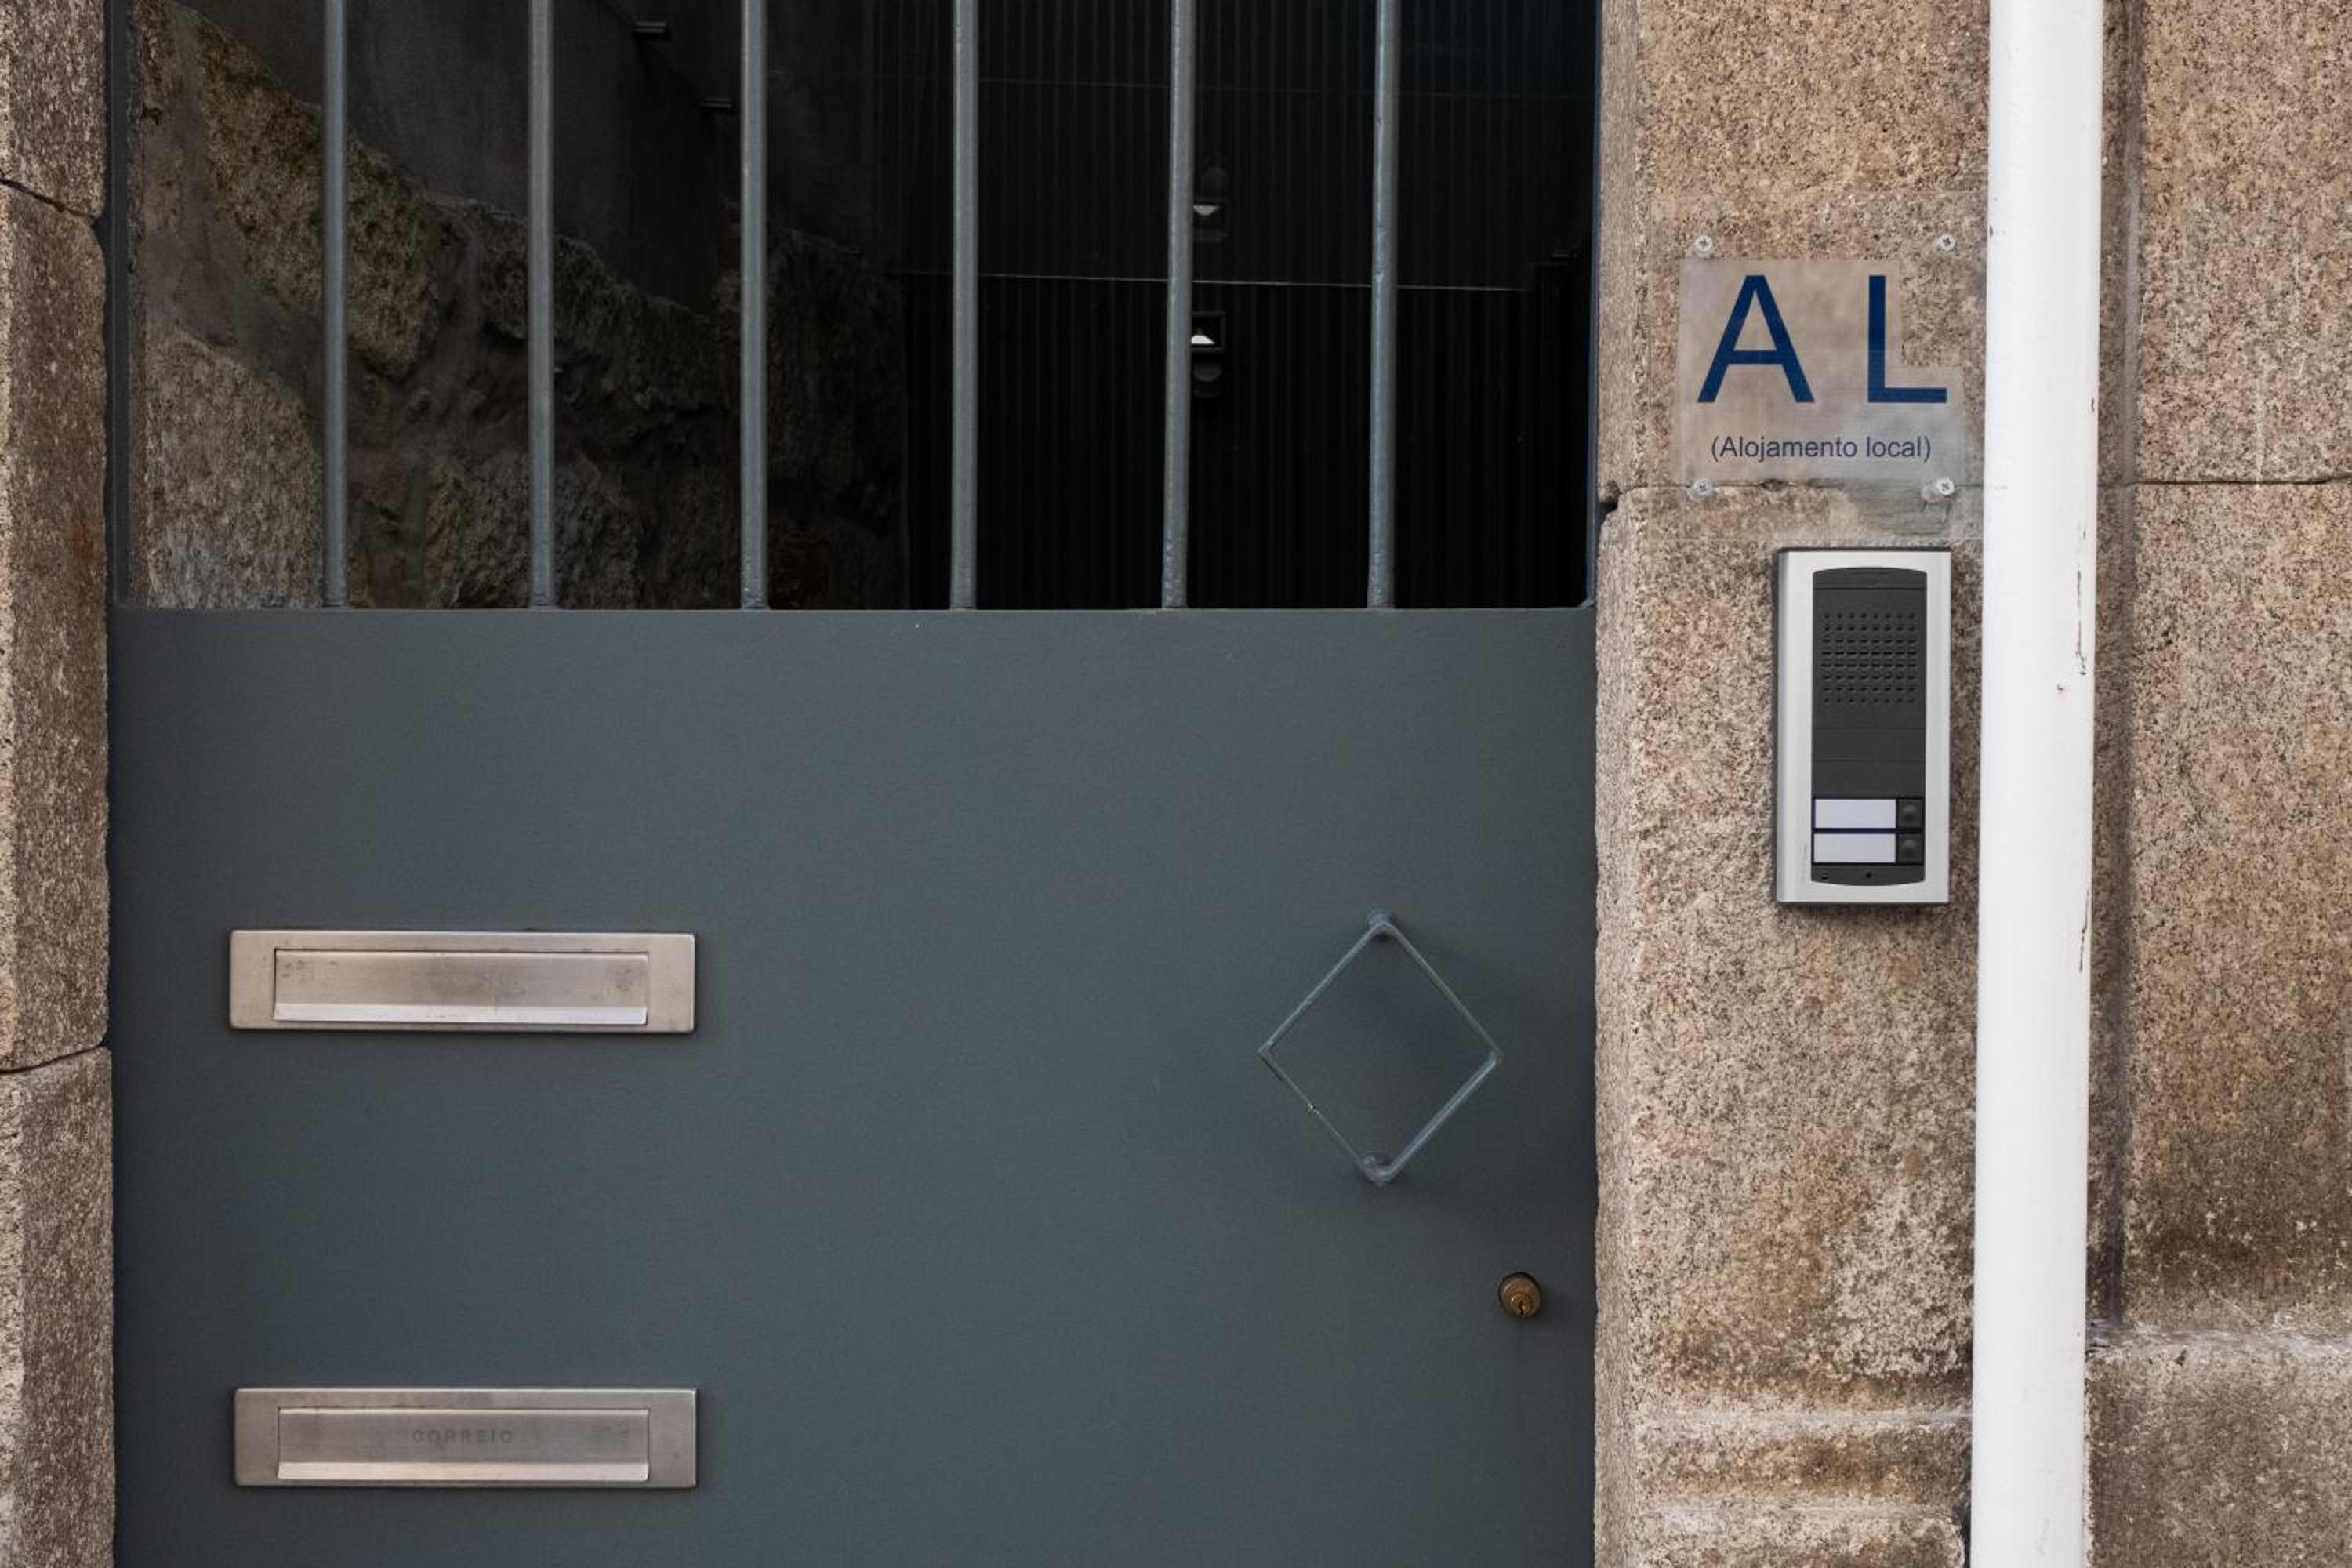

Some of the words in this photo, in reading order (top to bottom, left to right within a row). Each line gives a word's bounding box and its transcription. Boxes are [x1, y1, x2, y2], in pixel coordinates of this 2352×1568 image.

[1711, 436, 1858, 463] (Alojamento
[1866, 436, 1932, 463] local)
[412, 1429, 514, 1443] CORREIO
